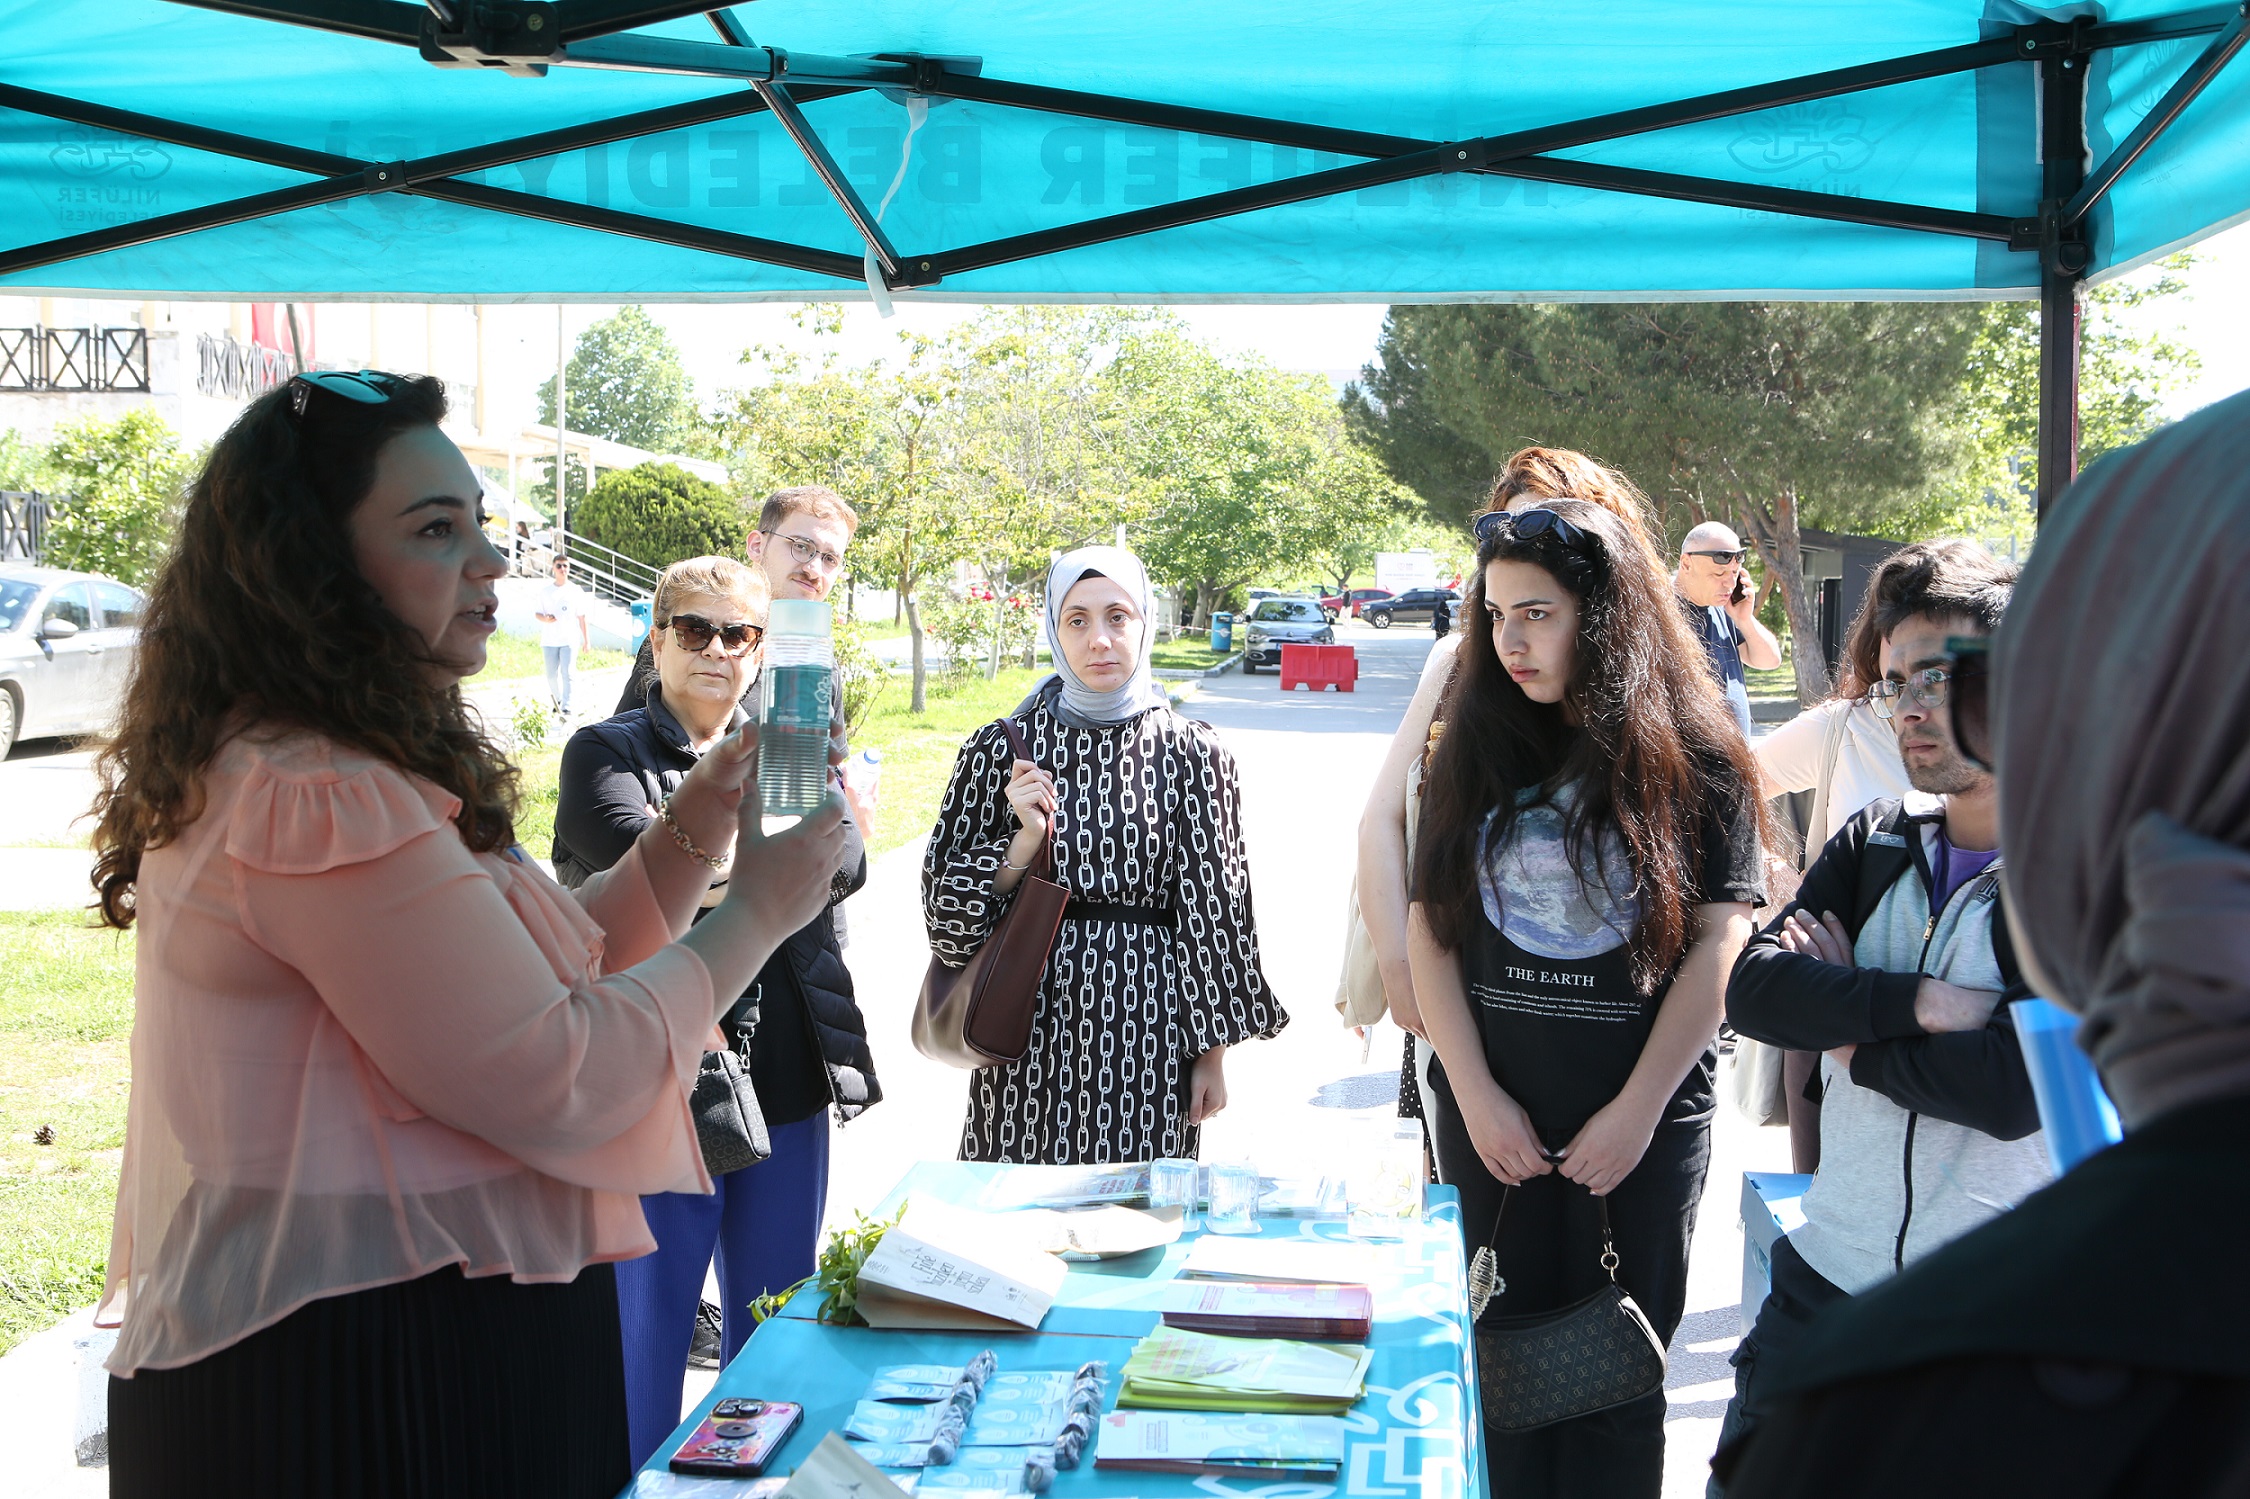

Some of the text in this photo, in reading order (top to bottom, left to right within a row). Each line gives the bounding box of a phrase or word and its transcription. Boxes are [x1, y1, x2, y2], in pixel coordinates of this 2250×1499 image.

[1505, 966, 1595, 987] THE EARTH
[911, 1255, 937, 1276] Fide
